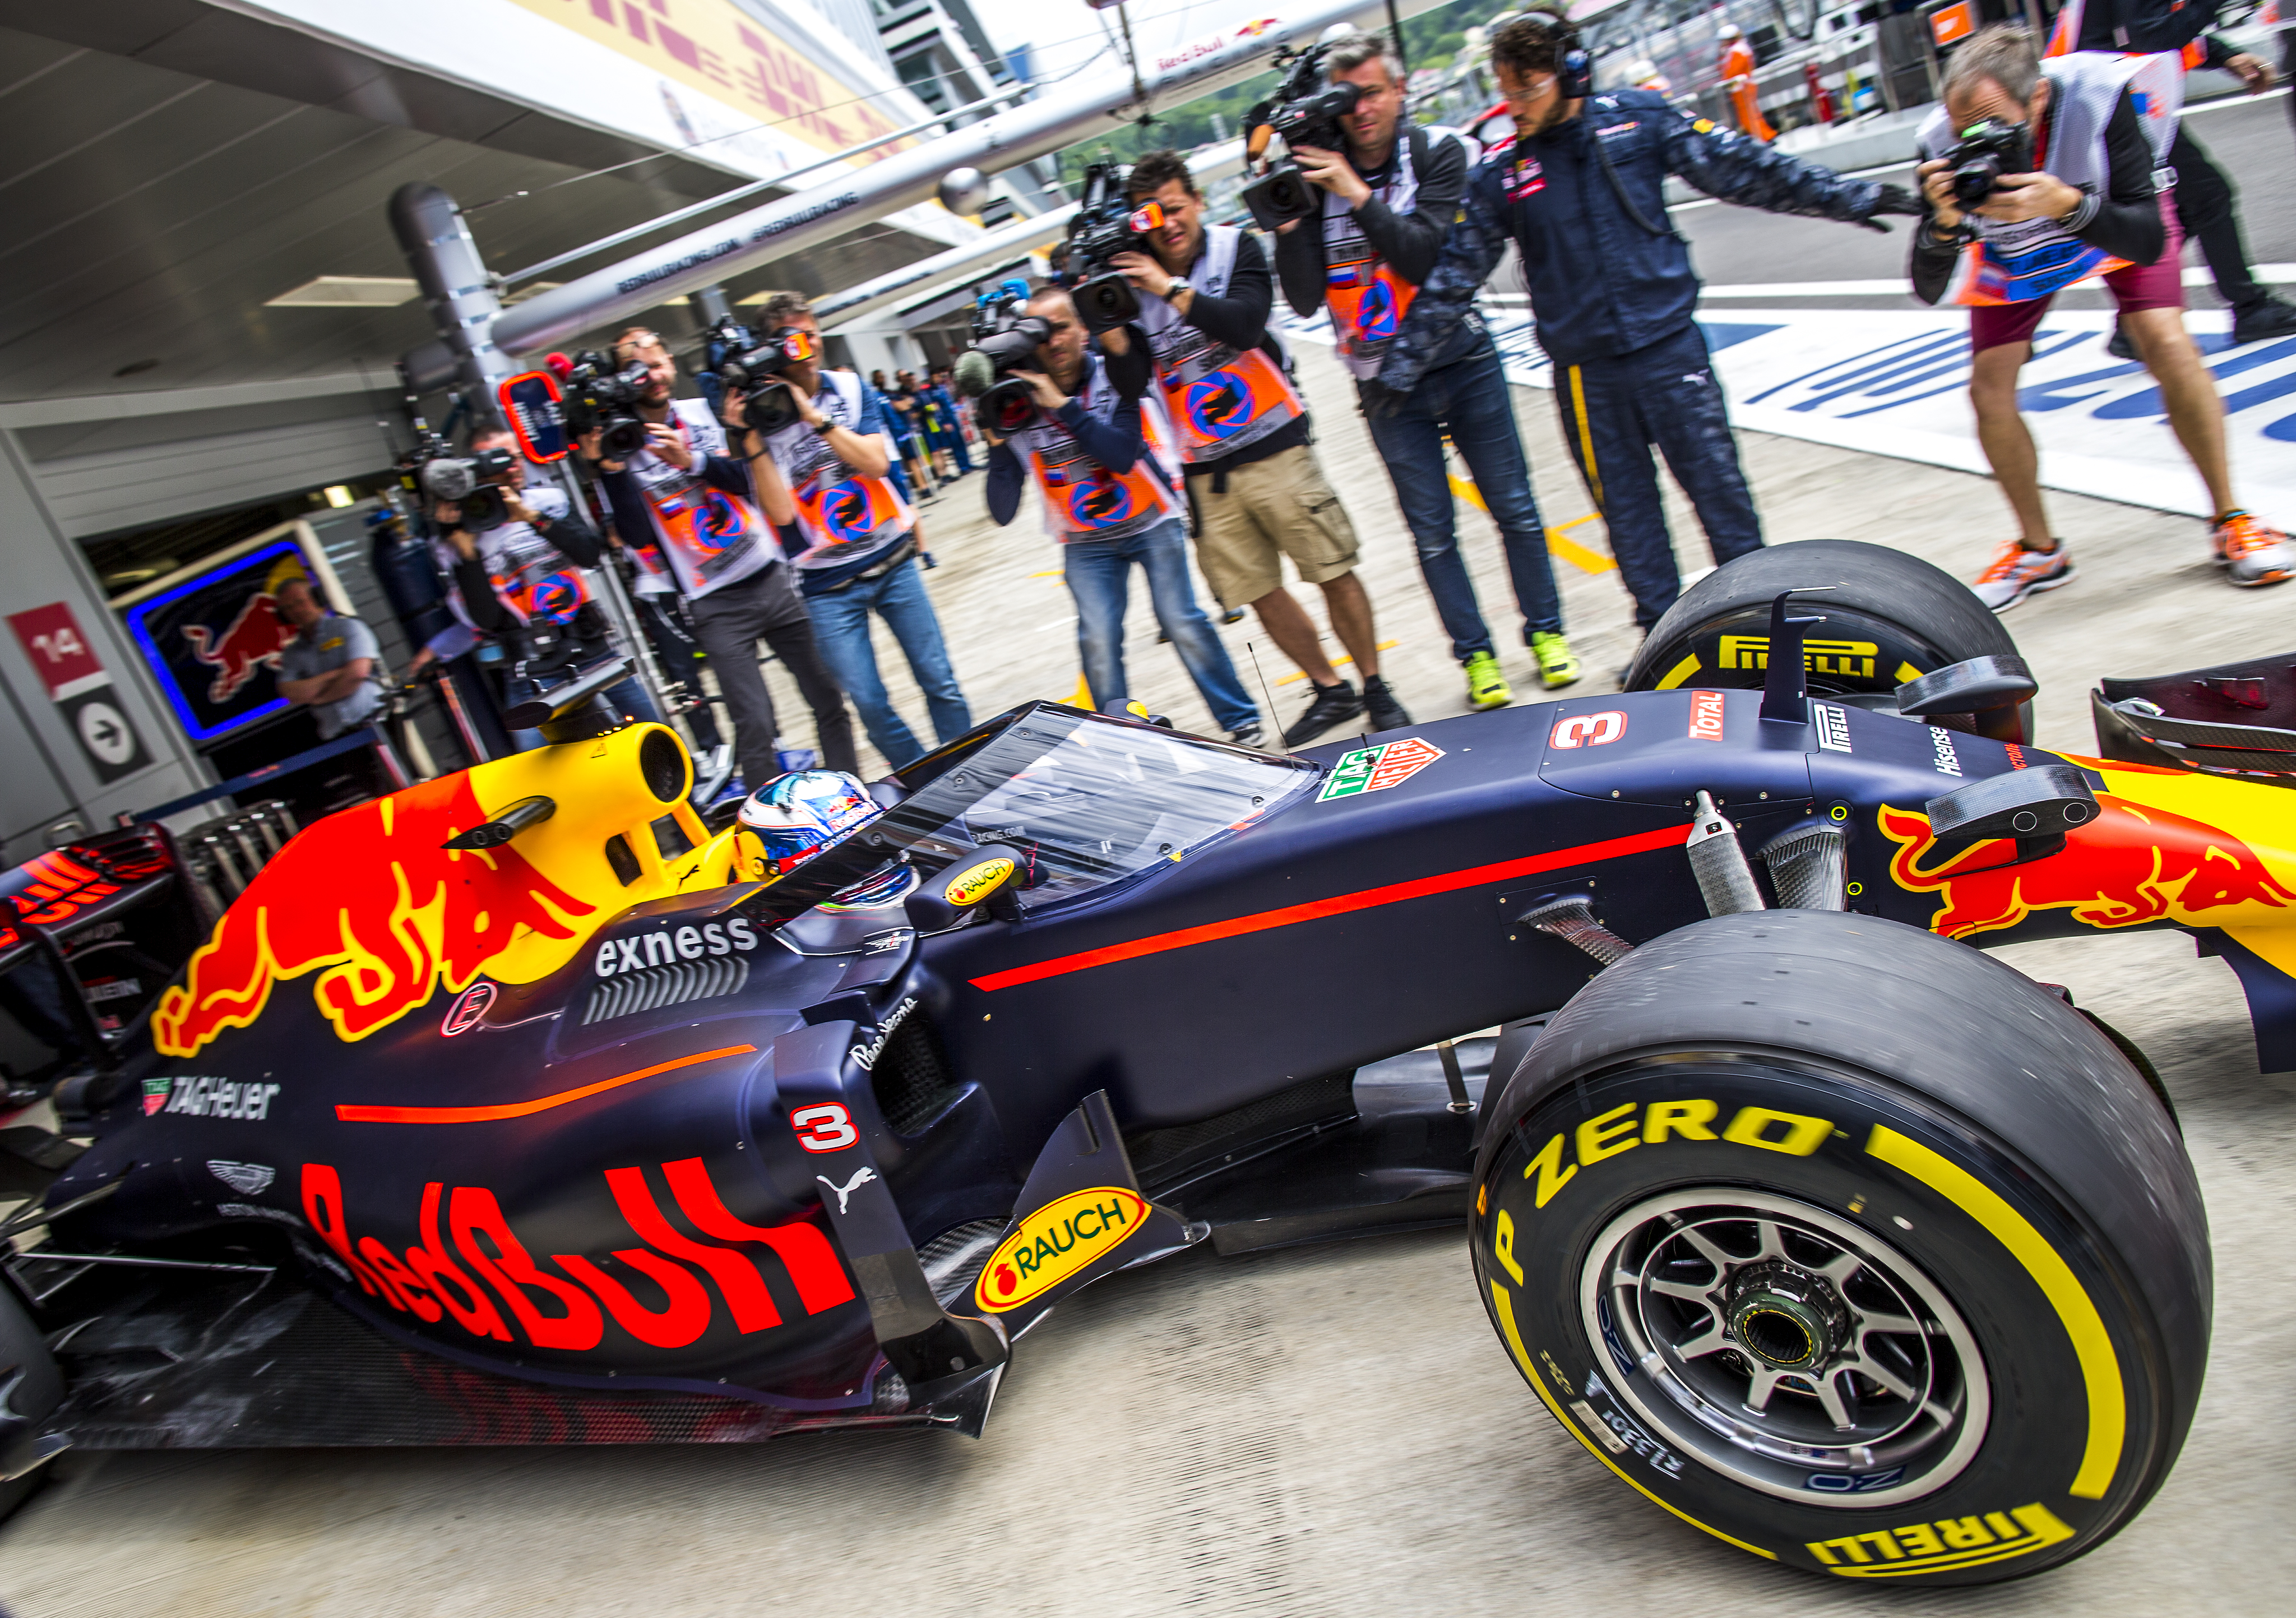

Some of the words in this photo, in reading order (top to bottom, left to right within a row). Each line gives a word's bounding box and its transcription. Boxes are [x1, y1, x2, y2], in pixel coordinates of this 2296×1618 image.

[32, 627, 85, 663] 14
[1719, 635, 1878, 678] PILLI
[1549, 710, 1628, 749] 3
[1691, 692, 1723, 739] TOTAL
[1814, 704, 1852, 753] PIRELLI
[1327, 746, 1382, 798] TAG
[1368, 739, 1422, 792] HEUER
[1929, 726, 1962, 778] Hisense
[961, 863, 1006, 895] RAUCH
[595, 918, 758, 977] exness
[790, 1102, 860, 1154] 3
[1496, 1209, 1524, 1287] P
[1523, 1099, 1835, 1209] ZERO
[1014, 1198, 1127, 1280] RAUCH
[1805, 1501, 2076, 1577] PIRELLI
